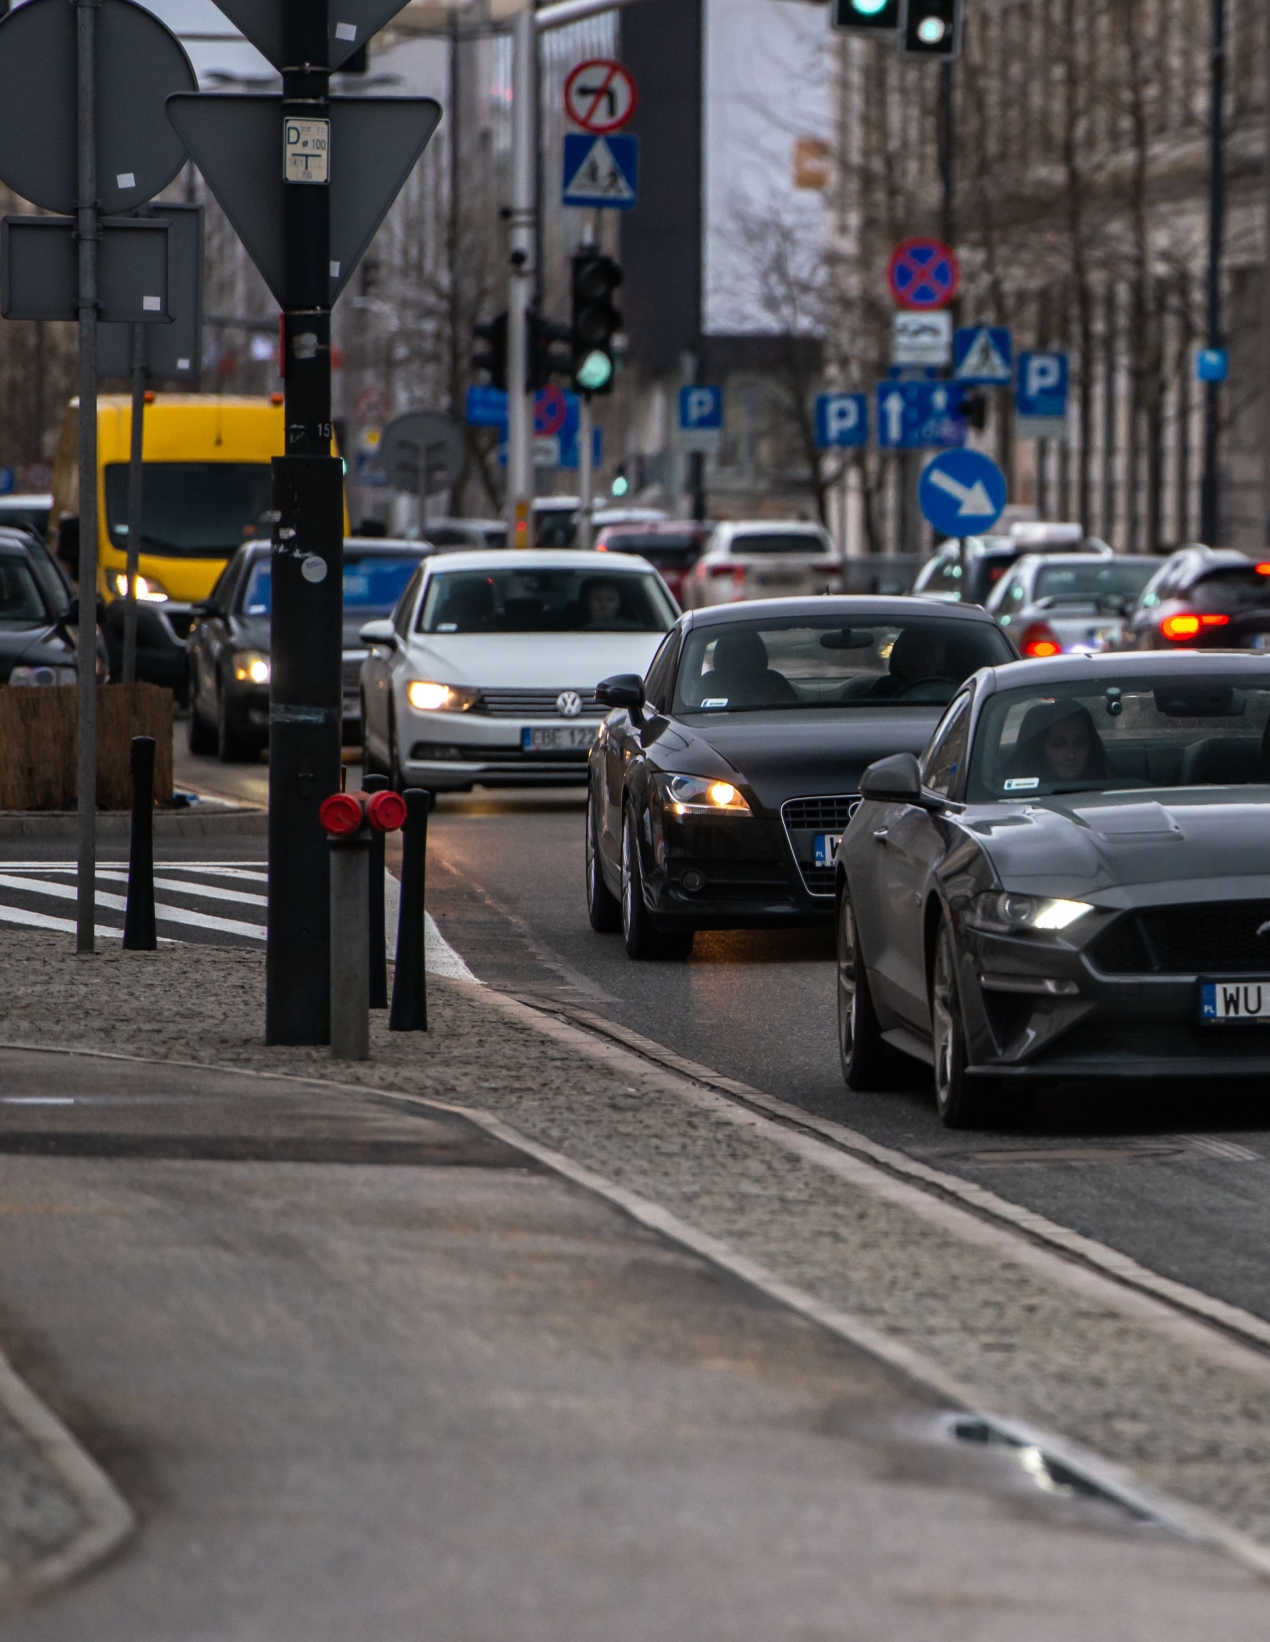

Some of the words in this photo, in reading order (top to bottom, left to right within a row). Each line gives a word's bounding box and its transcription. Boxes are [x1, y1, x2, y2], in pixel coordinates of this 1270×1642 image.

[287, 127, 300, 145] D
[1024, 355, 1061, 398] P
[687, 388, 714, 423] P
[826, 398, 859, 441] P
[317, 423, 331, 437] 15
[1204, 1004, 1215, 1013] PL
[1223, 985, 1262, 1015] WU
